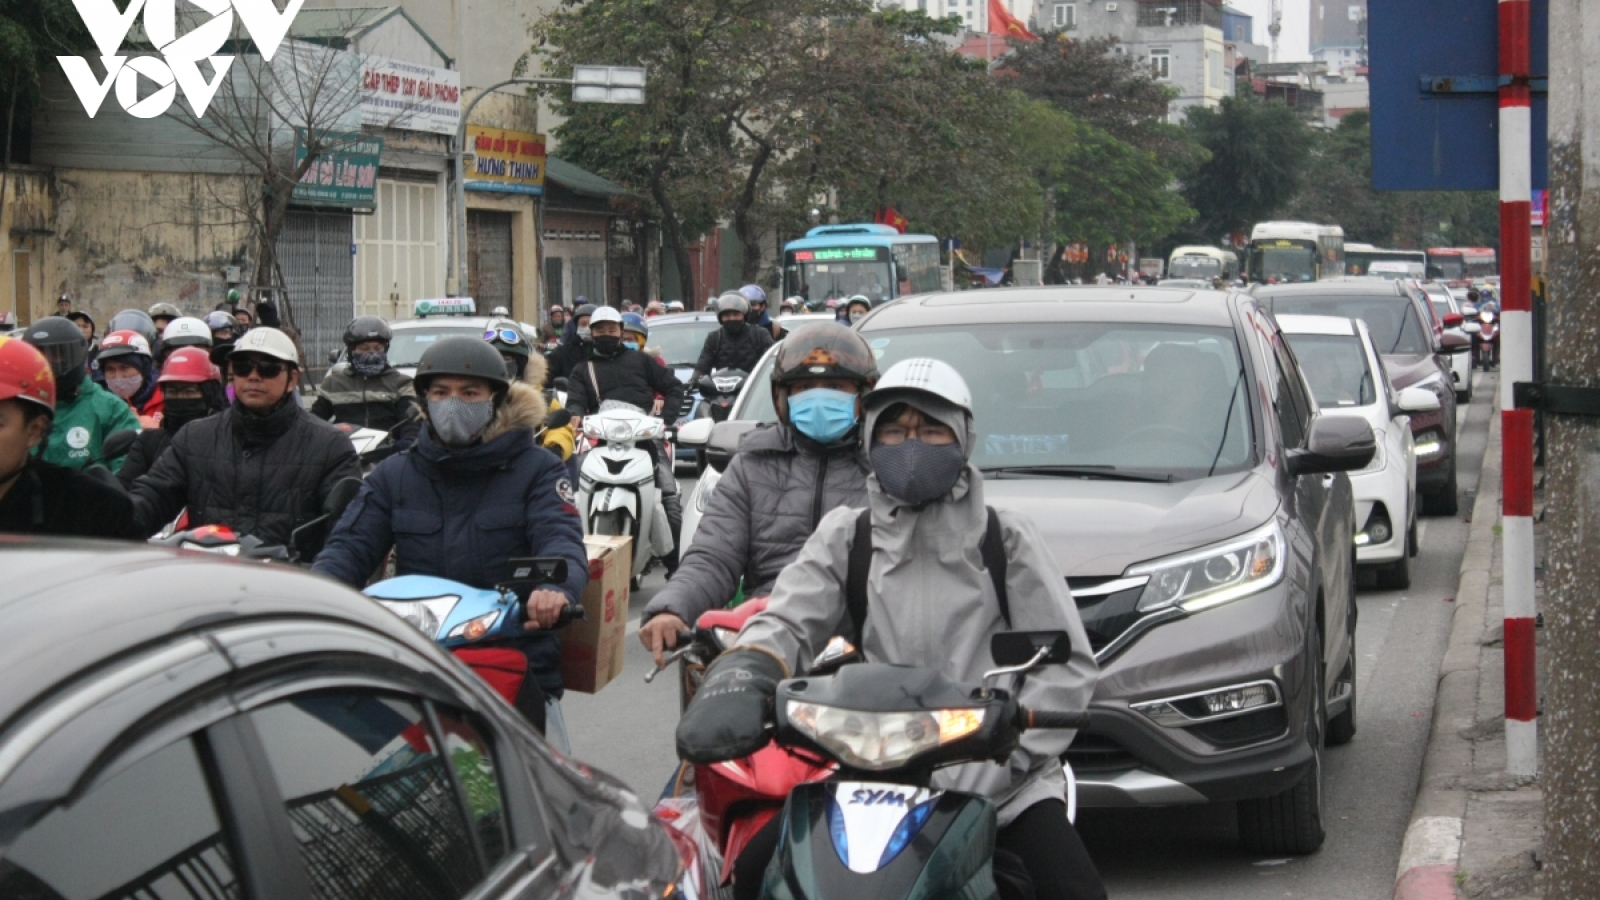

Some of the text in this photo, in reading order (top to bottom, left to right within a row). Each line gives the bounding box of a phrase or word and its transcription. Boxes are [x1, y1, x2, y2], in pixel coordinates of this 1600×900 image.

[477, 157, 539, 182] HƯNG THỊNH
[68, 448, 90, 458] Grab
[847, 789, 905, 807] SYM
